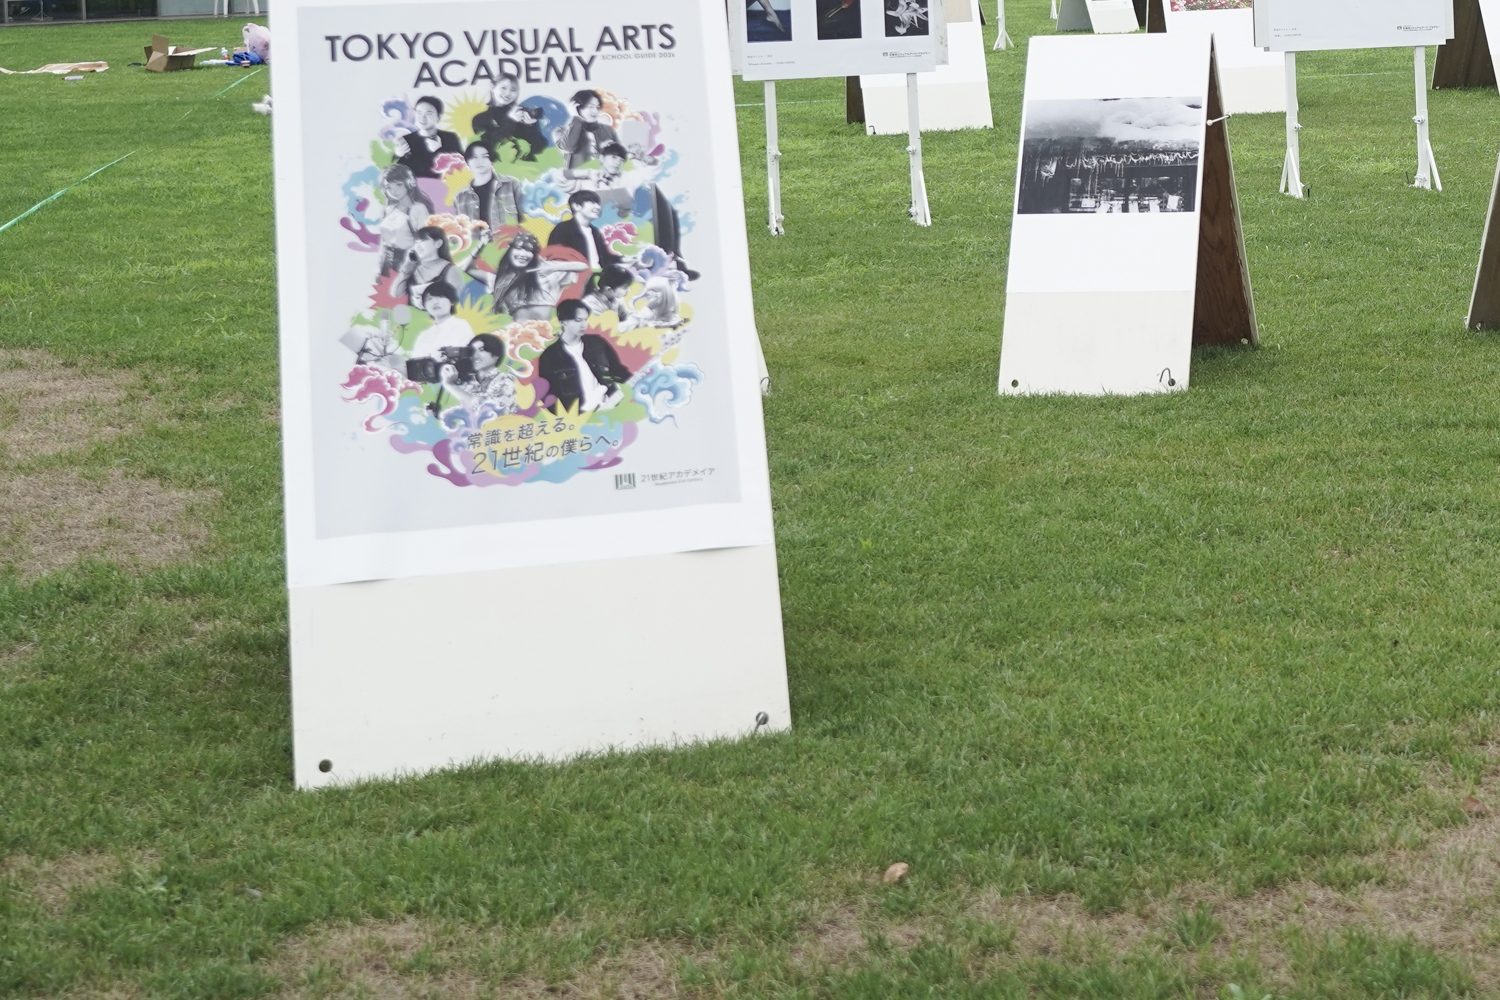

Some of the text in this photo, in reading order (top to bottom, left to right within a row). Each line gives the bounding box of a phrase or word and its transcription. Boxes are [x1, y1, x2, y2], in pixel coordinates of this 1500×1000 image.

[325, 23, 677, 62] TOKYO VISUAL ARTS
[413, 55, 597, 88] ACADEMY
[467, 417, 575, 450] 常識を超える。
[471, 435, 619, 475] 21世紀の僕らへ。
[641, 468, 715, 482] 21世紀アカデメイア
